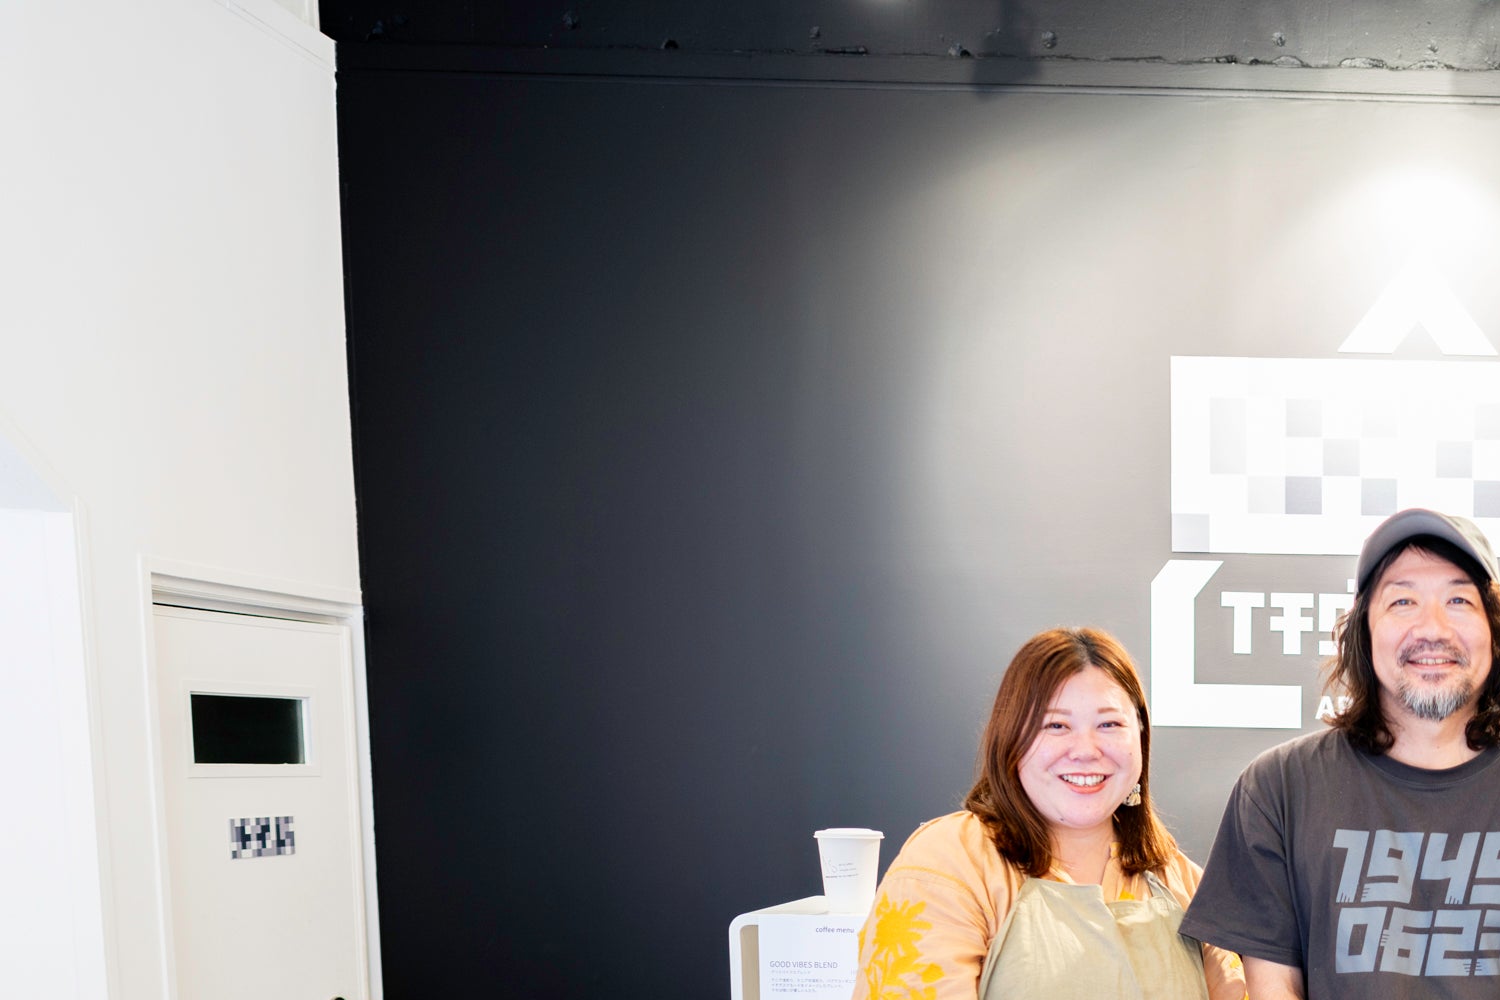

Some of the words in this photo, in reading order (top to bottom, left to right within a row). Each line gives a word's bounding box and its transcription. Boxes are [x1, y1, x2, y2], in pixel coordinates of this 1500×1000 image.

[769, 960, 791, 968] GOOD
[792, 961, 813, 969] VIBES
[814, 961, 839, 969] BLEND
